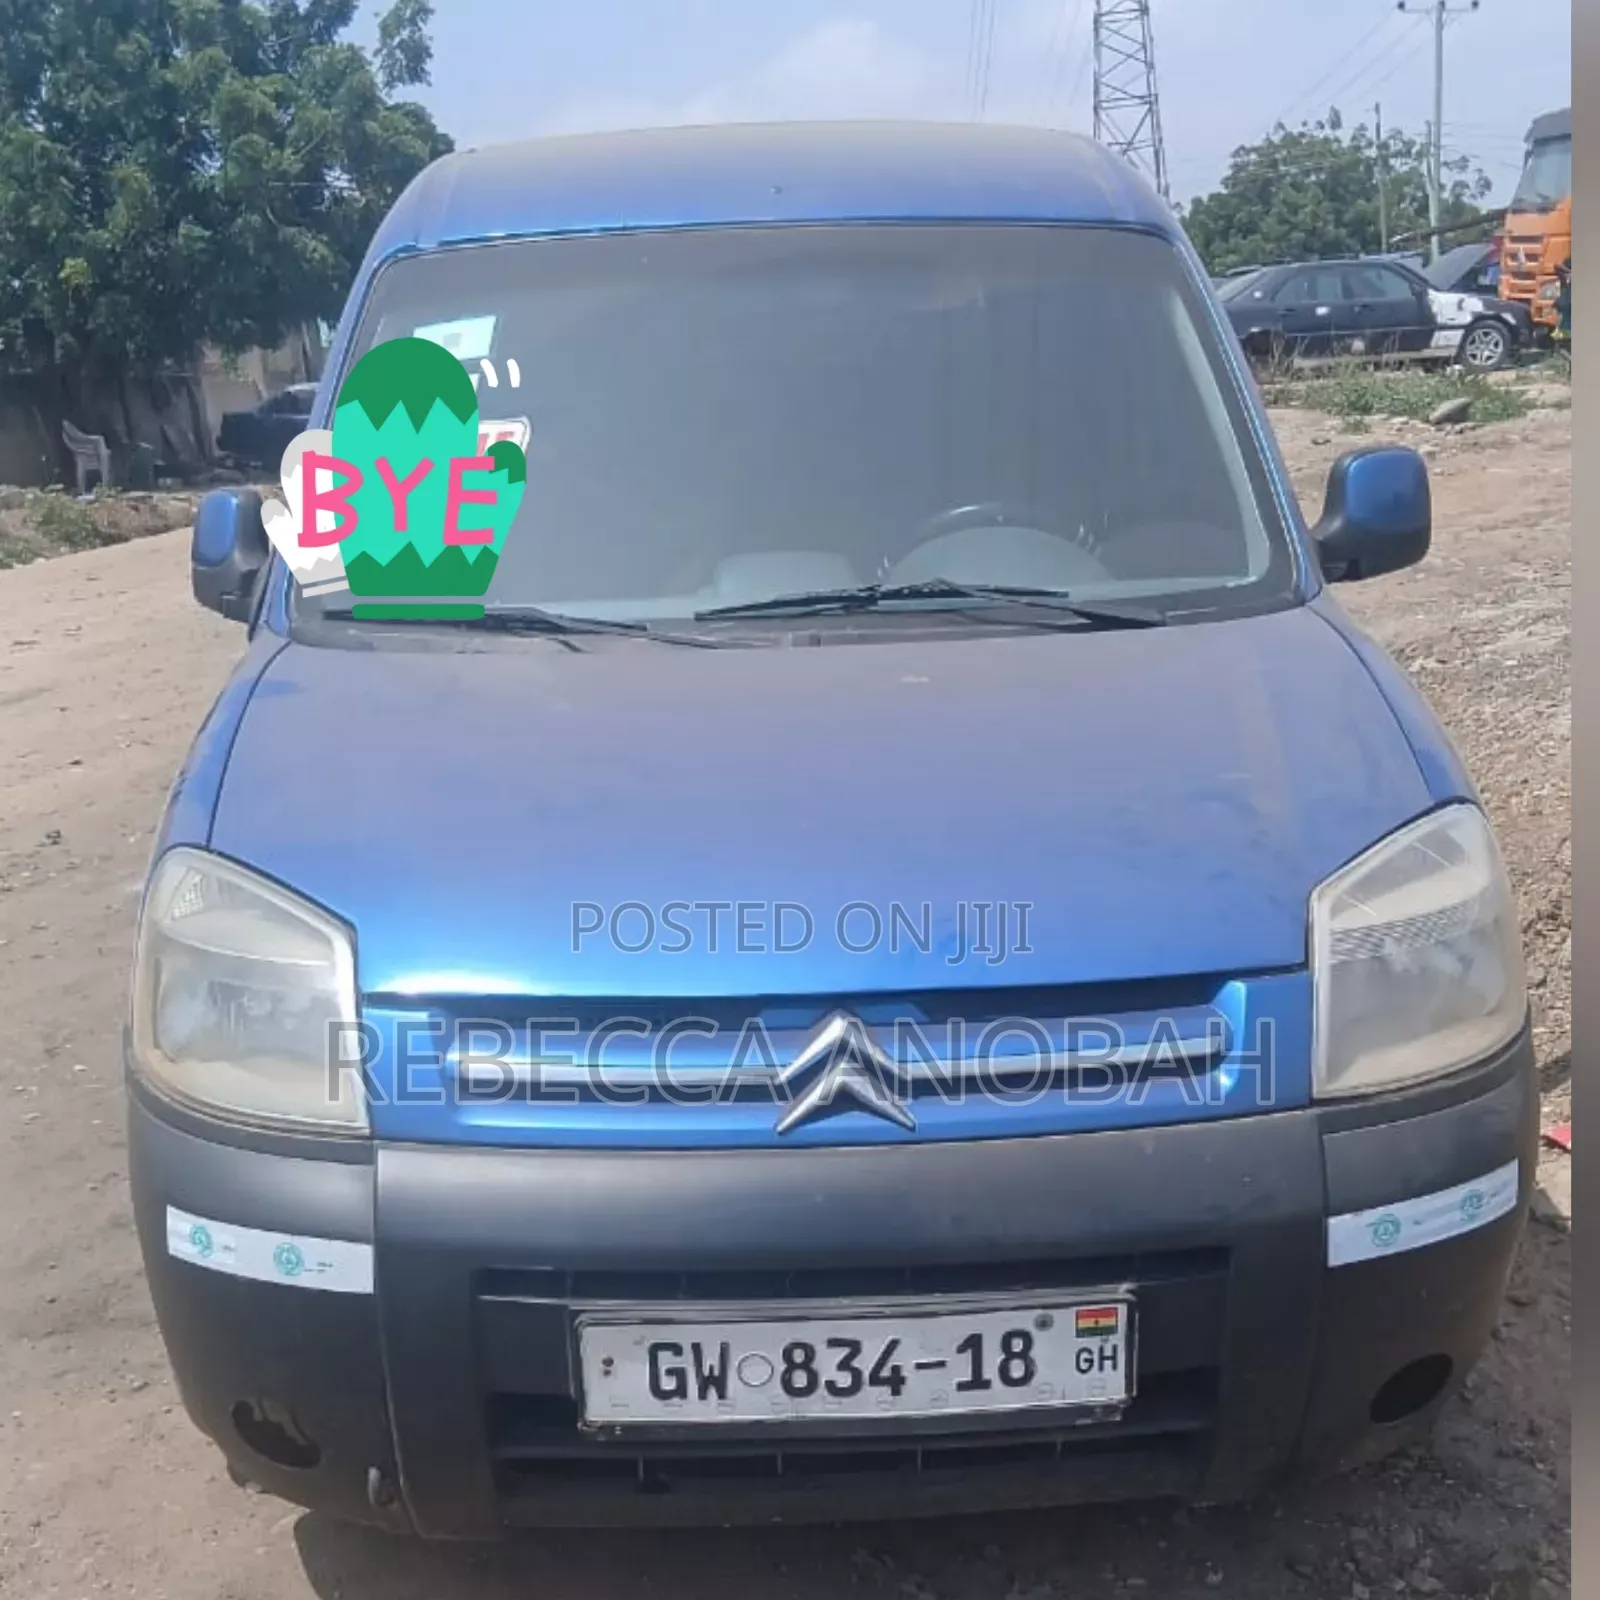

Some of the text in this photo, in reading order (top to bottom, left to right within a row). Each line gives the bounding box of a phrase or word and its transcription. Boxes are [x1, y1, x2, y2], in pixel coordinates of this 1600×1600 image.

[647, 1328, 1036, 1401] GW 834-18
[1075, 1343, 1118, 1375] GH
